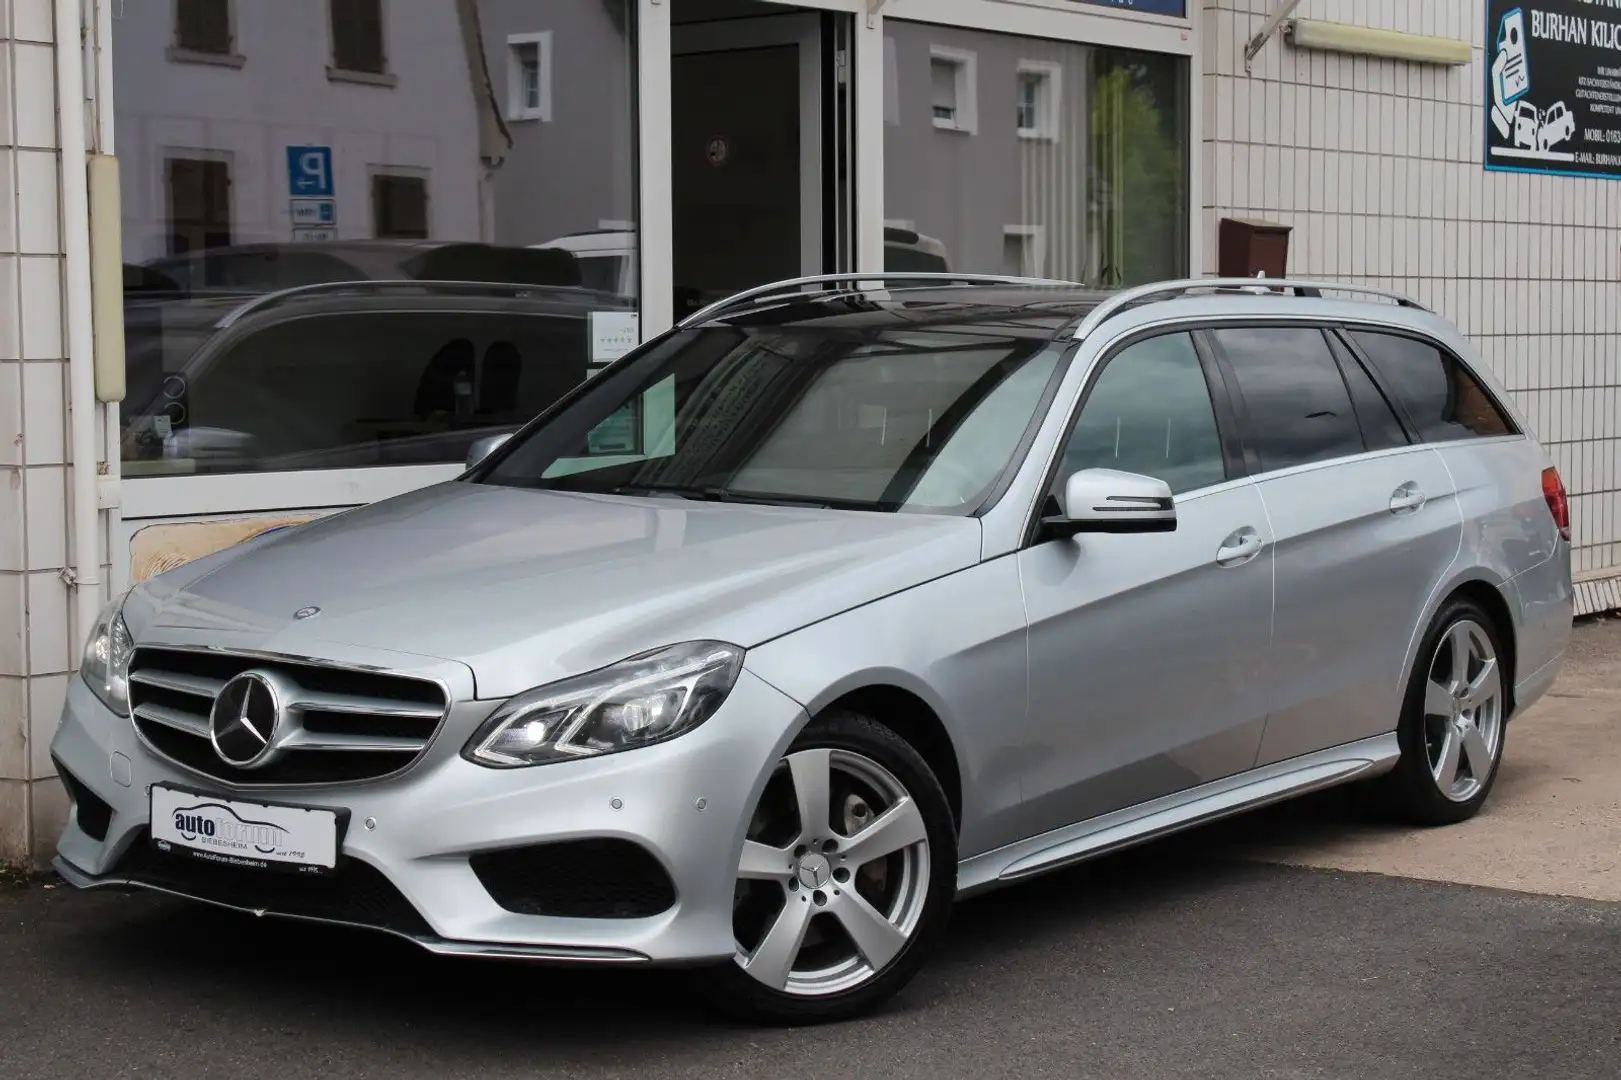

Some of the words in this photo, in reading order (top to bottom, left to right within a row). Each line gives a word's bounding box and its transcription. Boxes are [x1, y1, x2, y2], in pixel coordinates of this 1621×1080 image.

[1531, 9, 1587, 45] BURHAN
[1584, 127, 1605, 142] MOBIL:
[1575, 151, 1594, 164] E-MAIL:
[201, 837, 248, 850] BIEBESHEIM
